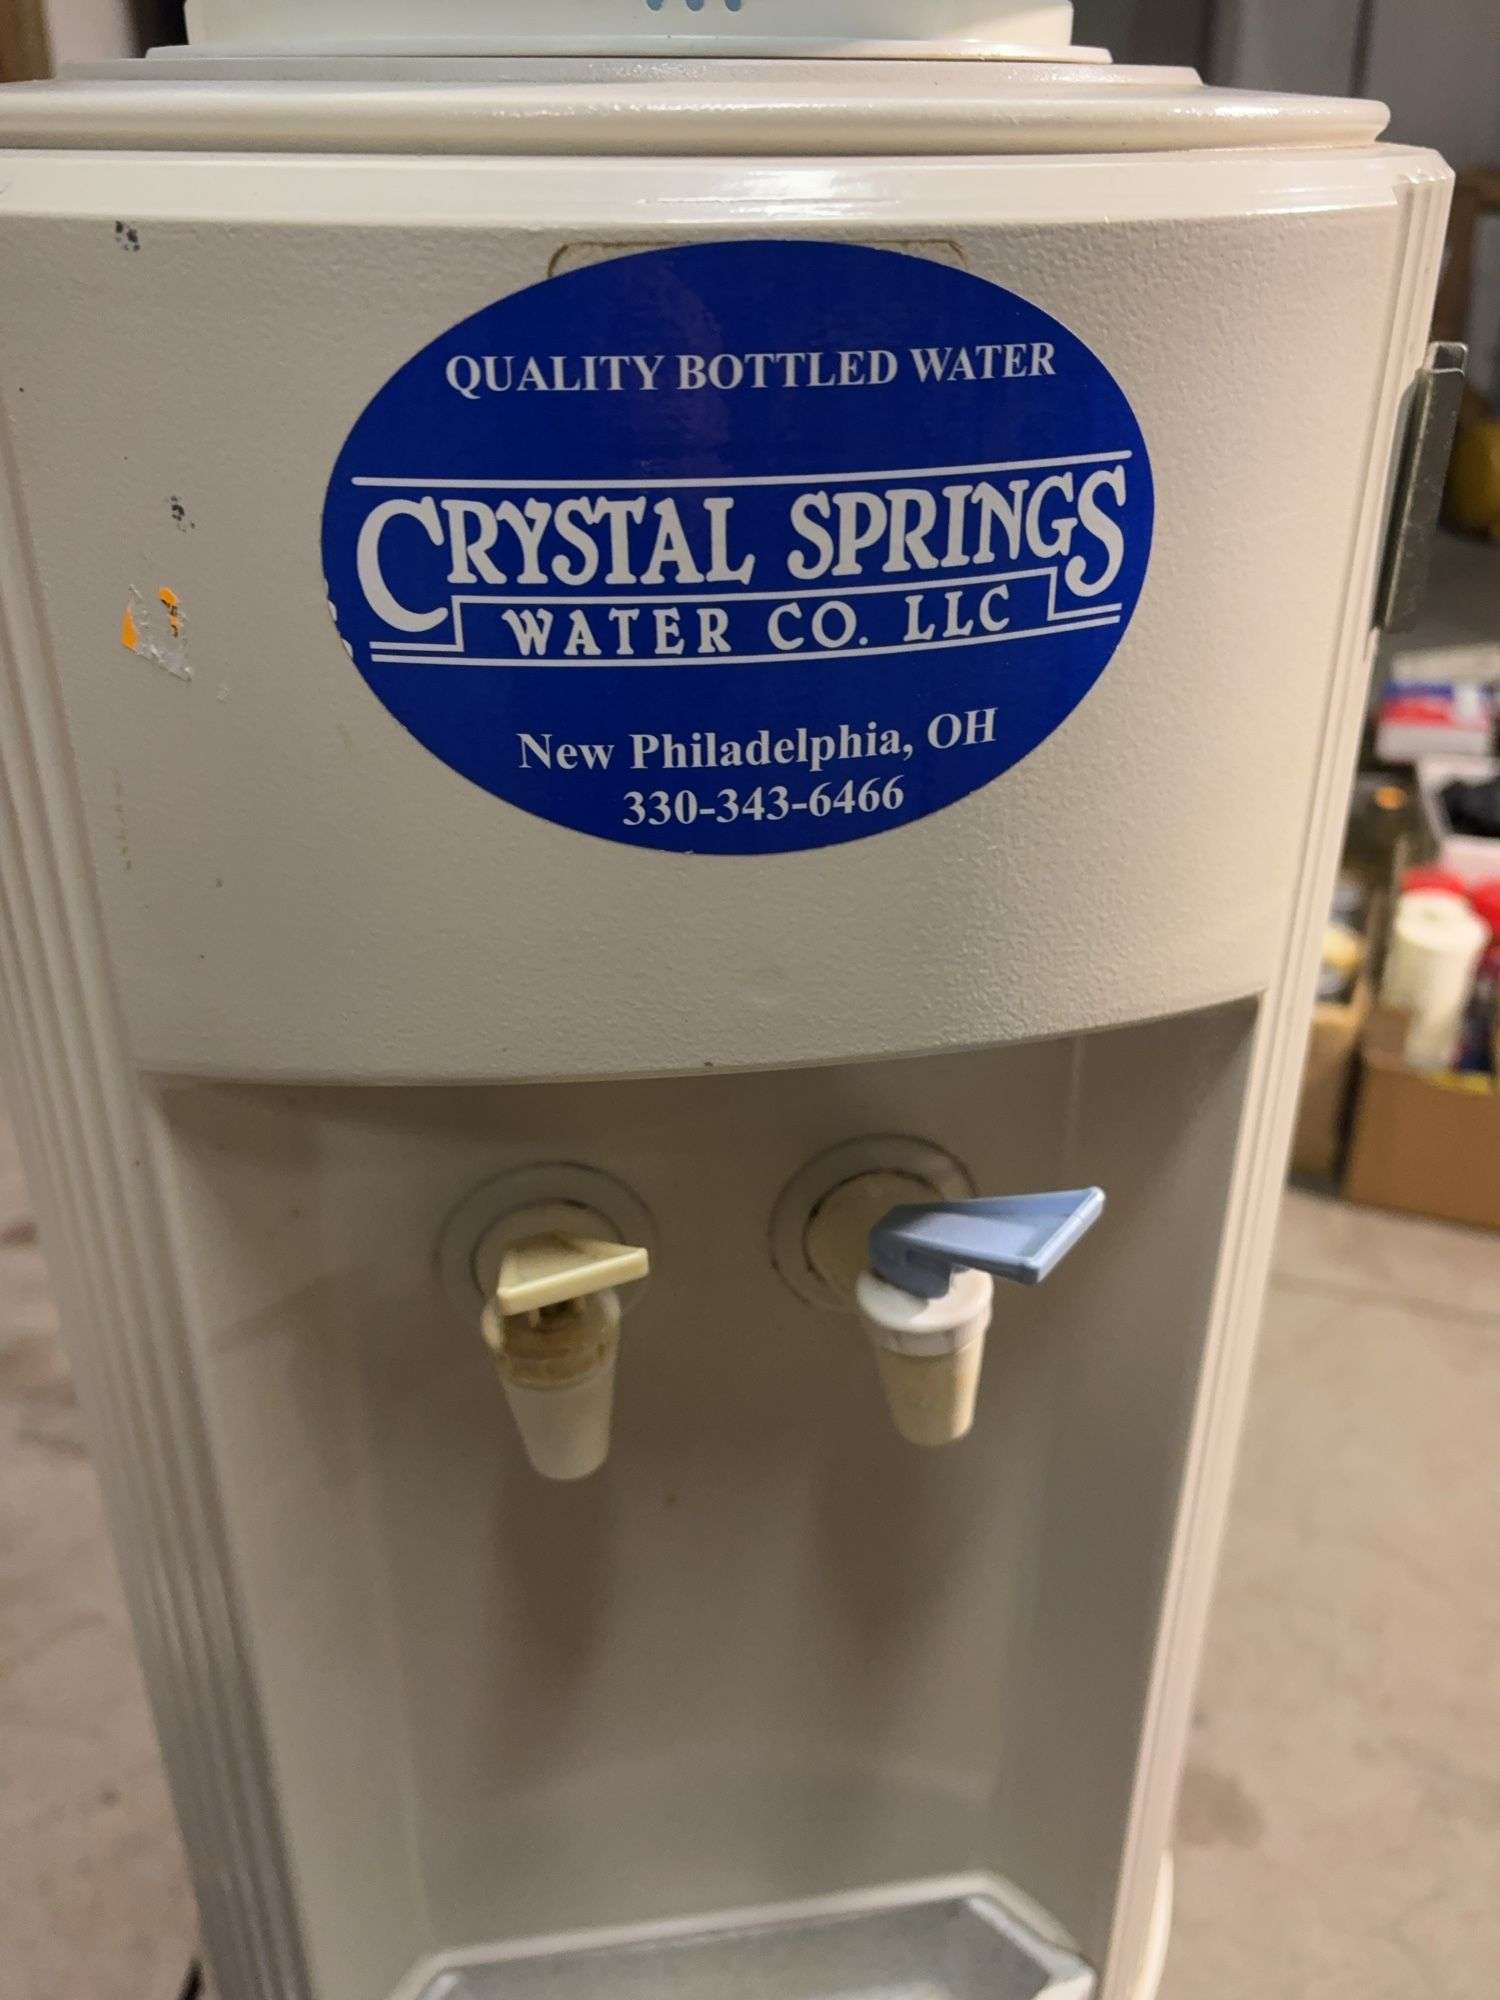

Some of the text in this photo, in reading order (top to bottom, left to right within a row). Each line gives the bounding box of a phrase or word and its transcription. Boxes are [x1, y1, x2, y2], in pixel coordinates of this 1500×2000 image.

[446, 342, 1056, 400] QUALITY BOTTLED WATER
[356, 464, 1127, 633] CRYSTAL SPRINGS
[501, 584, 1010, 656] WATER CO. LLC
[517, 707, 996, 772] New Philadelphia, OH
[623, 775, 904, 826] 330-343-6466
